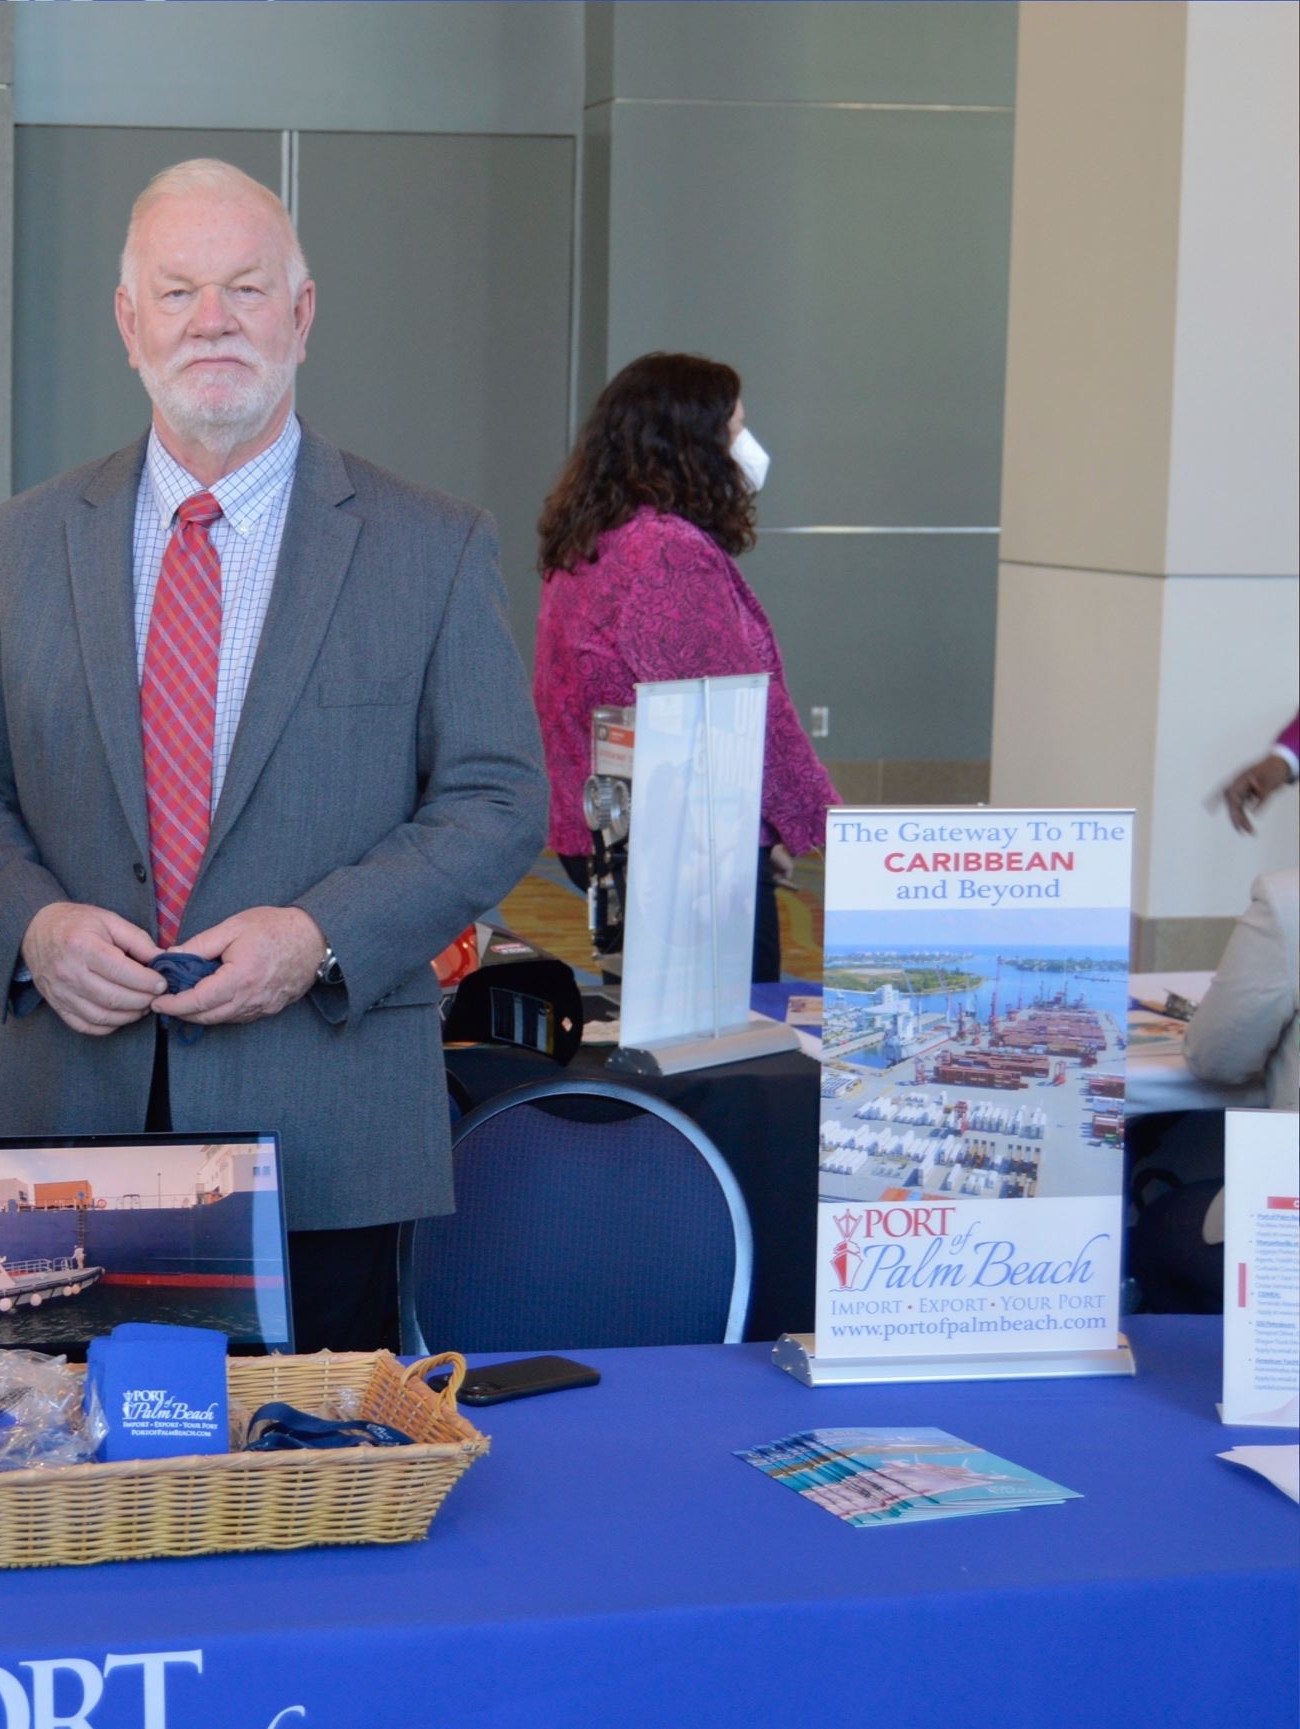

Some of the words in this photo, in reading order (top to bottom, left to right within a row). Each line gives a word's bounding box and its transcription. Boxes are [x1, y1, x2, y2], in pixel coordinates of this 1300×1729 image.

[833, 823, 888, 842] The
[898, 822, 1018, 849] Gateway
[1026, 822, 1062, 841] To
[1070, 821, 1125, 841] The
[884, 851, 1074, 873] CARIBBEAN
[896, 879, 948, 900] and
[958, 878, 1061, 906] Beyond
[863, 1207, 957, 1239] PORT
[950, 1221, 981, 1255] of
[863, 1237, 968, 1292] Palm
[969, 1233, 1111, 1288] Beach
[831, 1316, 1107, 1341] www.portofpalmbeach.com
[133, 1400, 172, 1420] Palm
[172, 1402, 219, 1420] Beach
[134, 1390, 168, 1402] PORT
